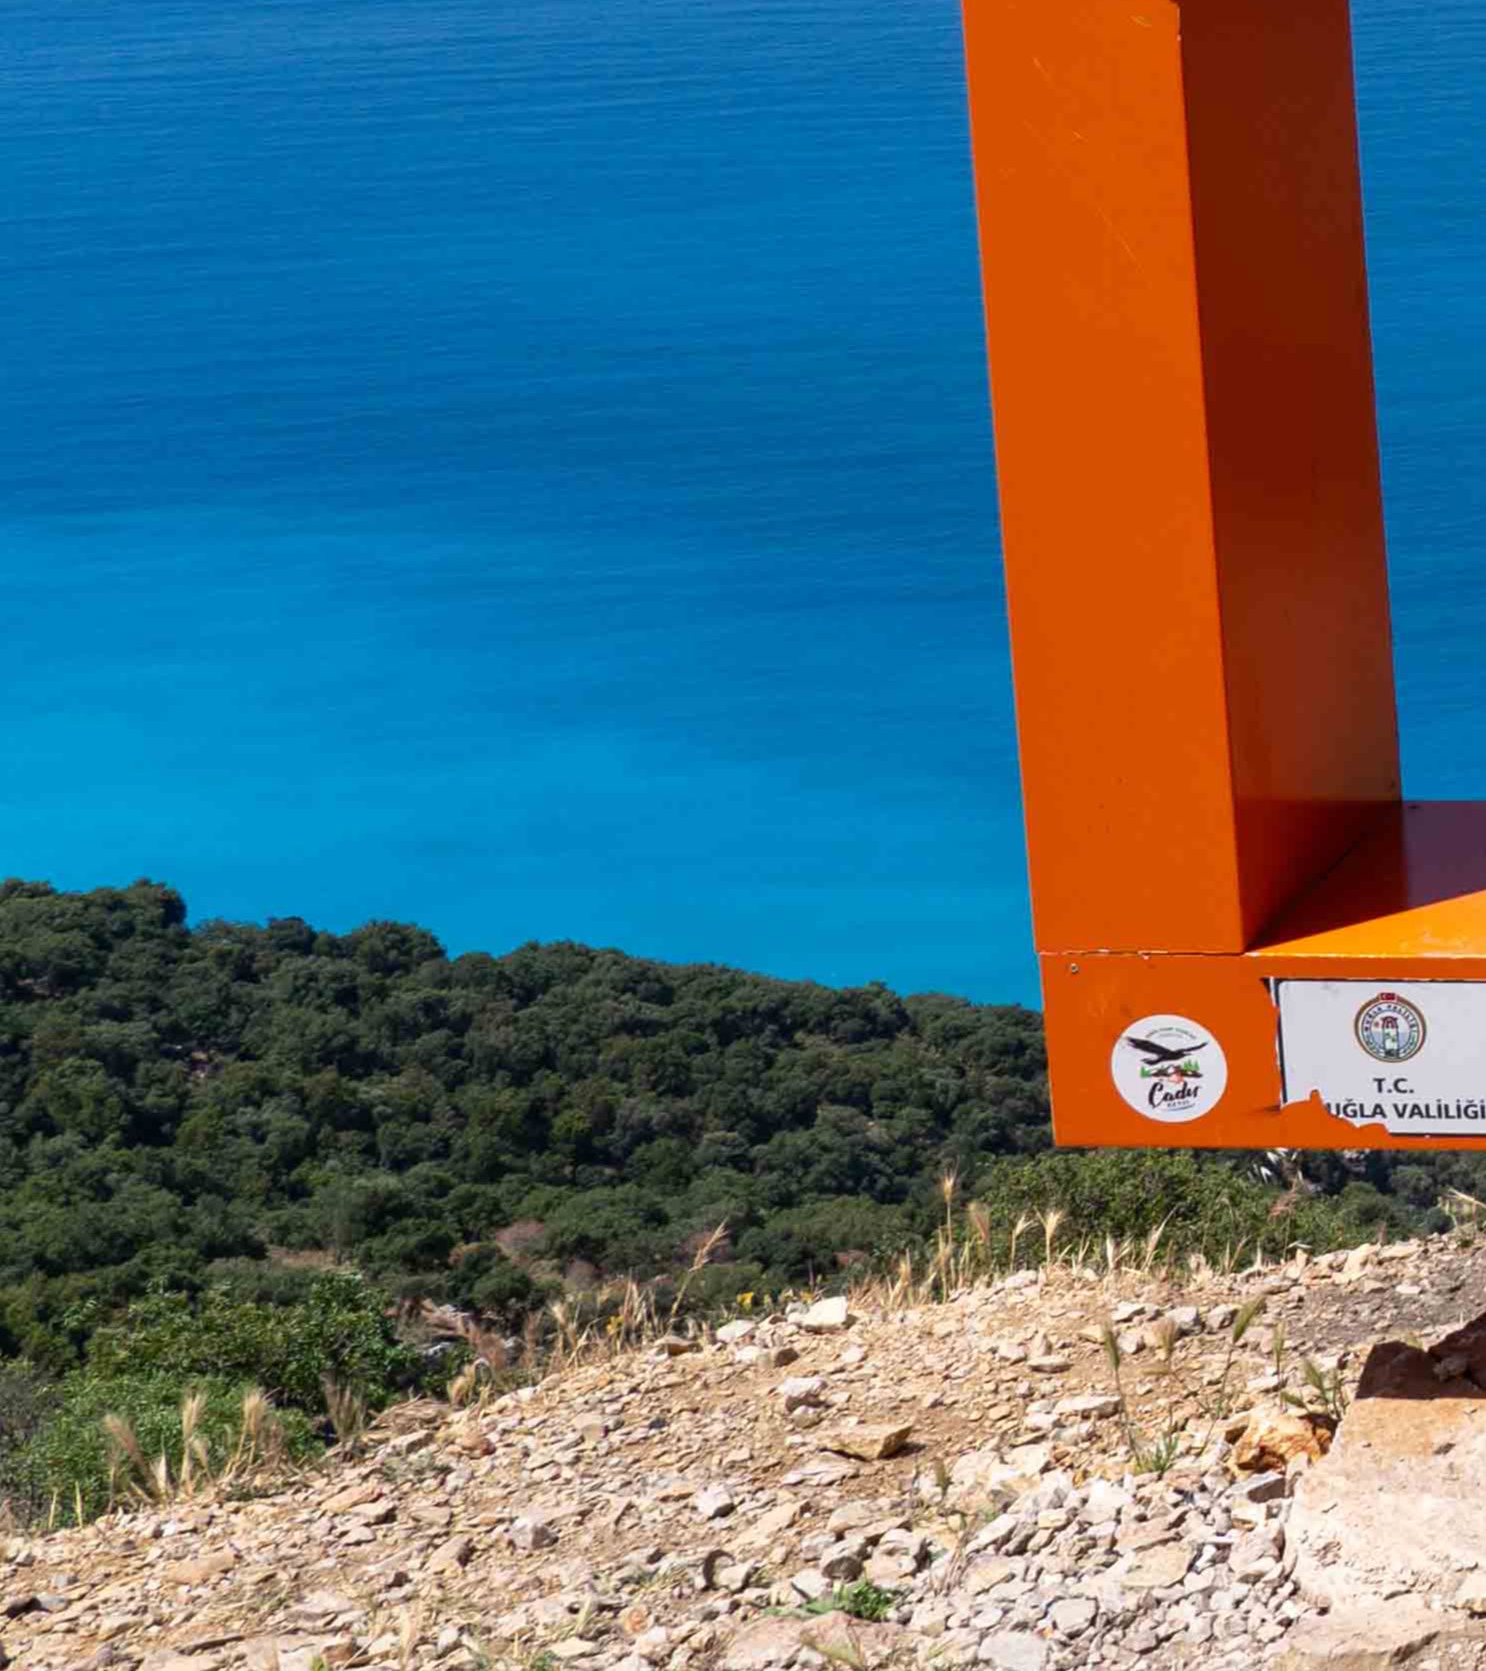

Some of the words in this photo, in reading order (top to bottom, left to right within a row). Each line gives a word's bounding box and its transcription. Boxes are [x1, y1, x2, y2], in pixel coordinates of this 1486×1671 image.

[1373, 1078, 1414, 1093] T.C.
[1327, 1098, 1387, 1119] UĞLA
[1392, 1098, 1486, 1120] VALİLİĞİ
